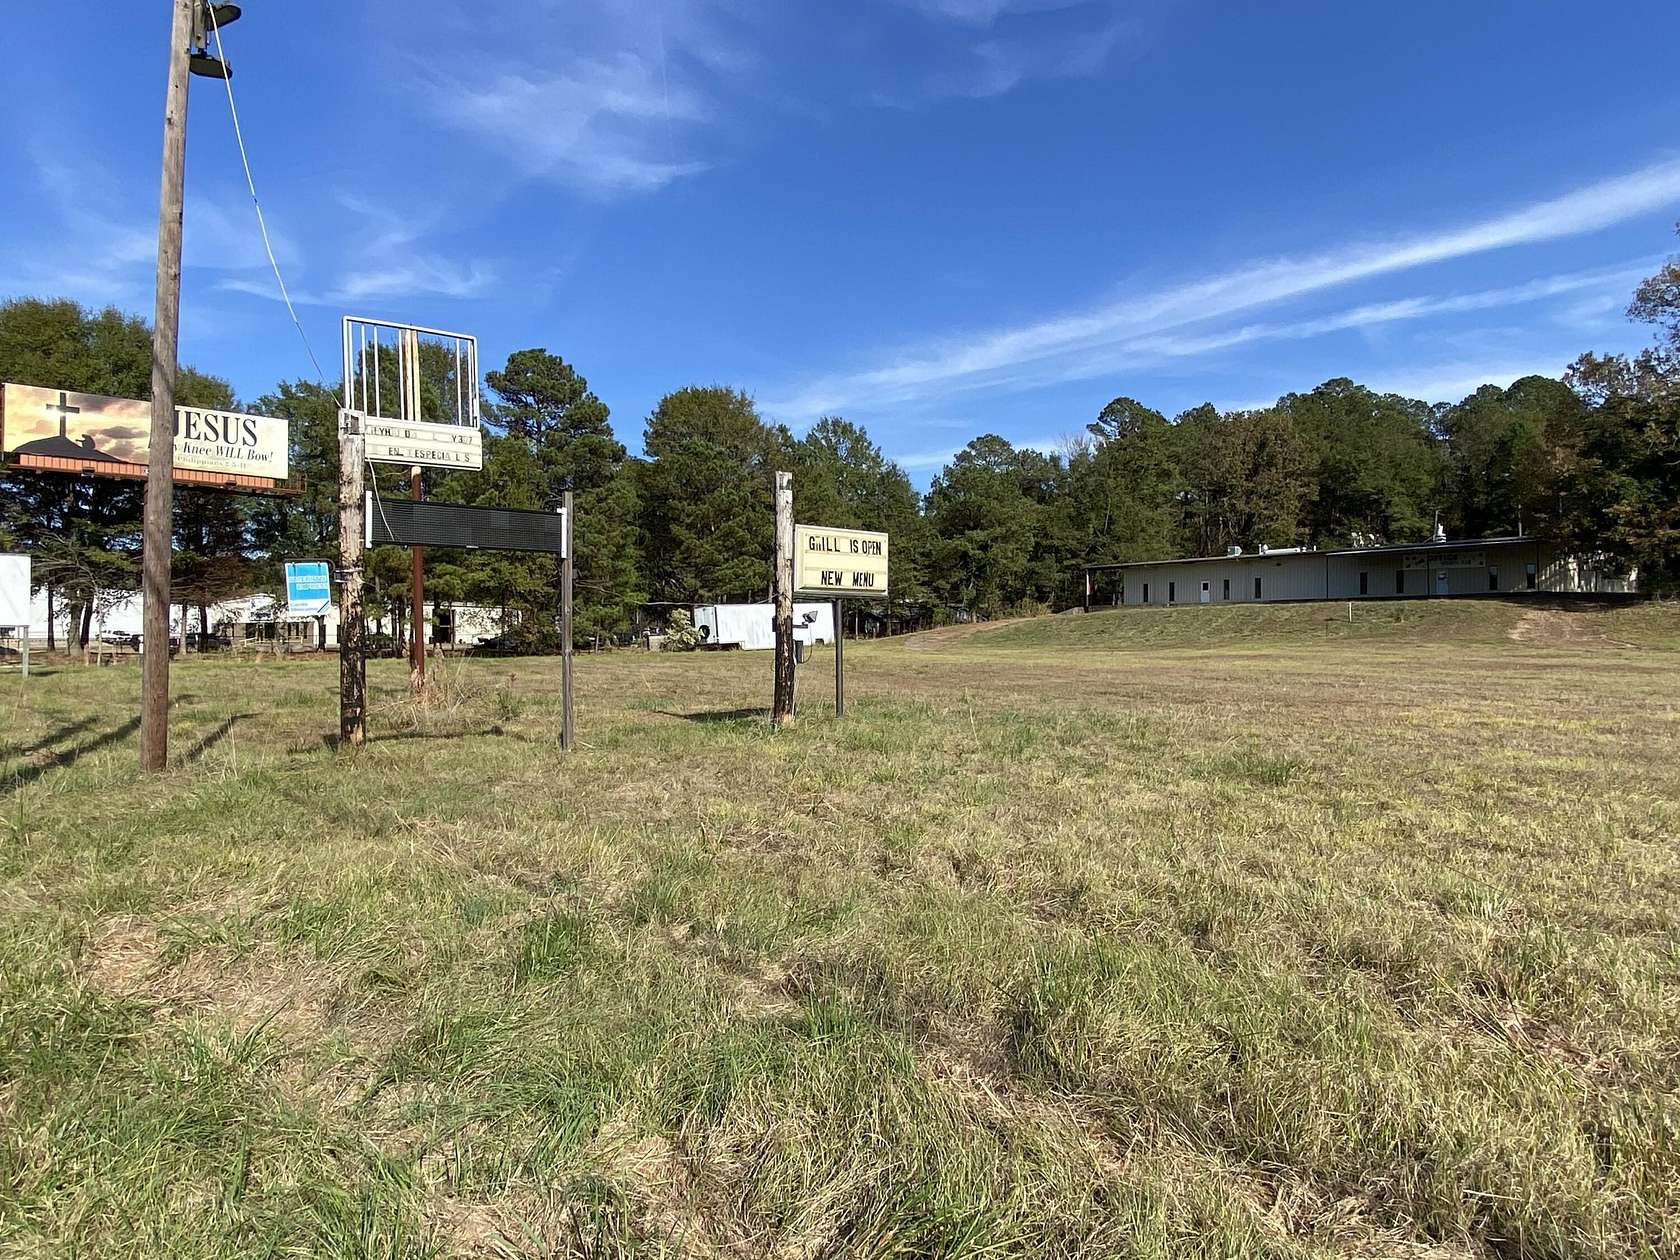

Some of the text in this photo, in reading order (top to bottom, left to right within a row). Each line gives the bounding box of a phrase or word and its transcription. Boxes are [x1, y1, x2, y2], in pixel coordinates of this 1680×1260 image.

[173, 410, 258, 447] JESUS
[183, 442, 212, 456] Knee
[216, 445, 244, 459] WILL
[247, 449, 274, 462] Bow!
[850, 539, 859, 553] IS
[862, 540, 882, 555] OPEN
[820, 571, 874, 587] NEW MENU
